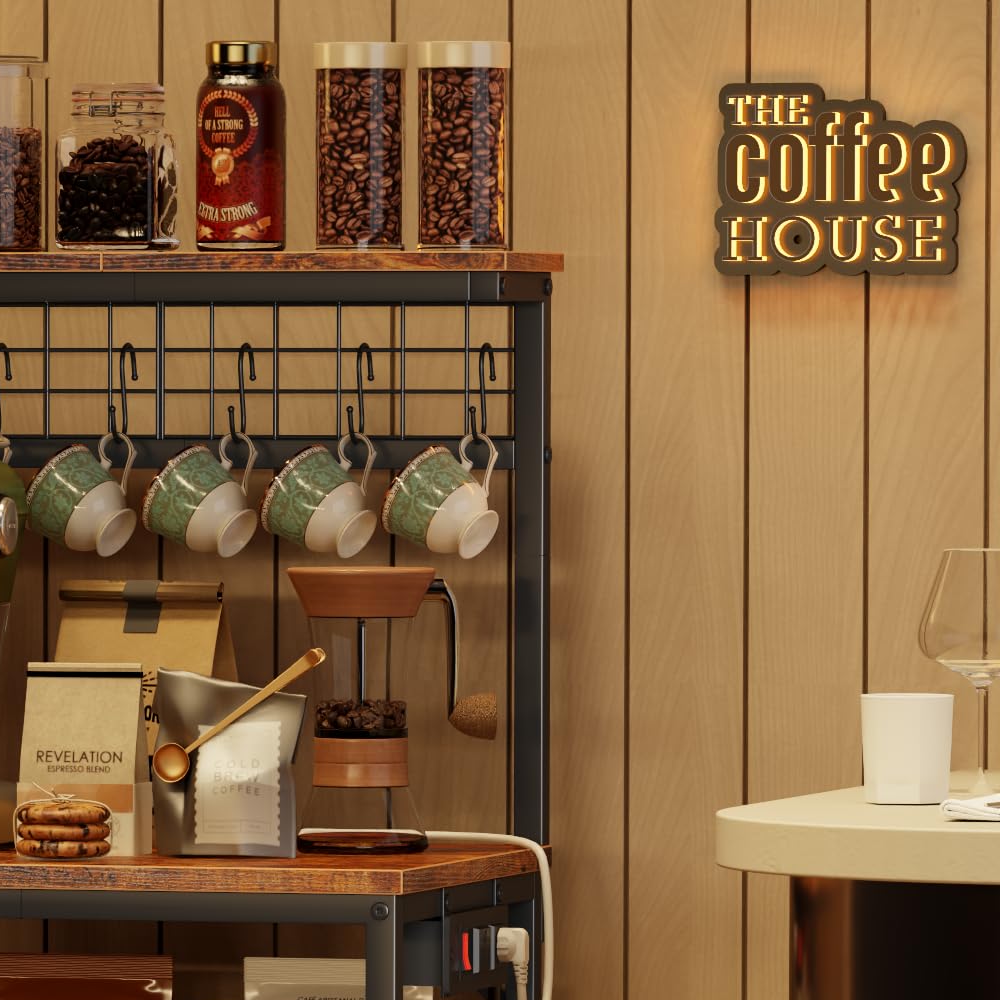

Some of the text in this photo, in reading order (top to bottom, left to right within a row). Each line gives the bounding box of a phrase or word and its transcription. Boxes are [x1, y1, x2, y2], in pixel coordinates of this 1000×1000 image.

[214, 106, 231, 118] HELL
[726, 94, 810, 126] THE
[217, 119, 244, 131] STRONG
[211, 132, 236, 144] COFFEE
[221, 201, 258, 222] STRONG
[721, 214, 944, 263] HOUSE
[36, 750, 123, 764] REVELATION
[47, 765, 111, 774] ESPRESSO BLEND
